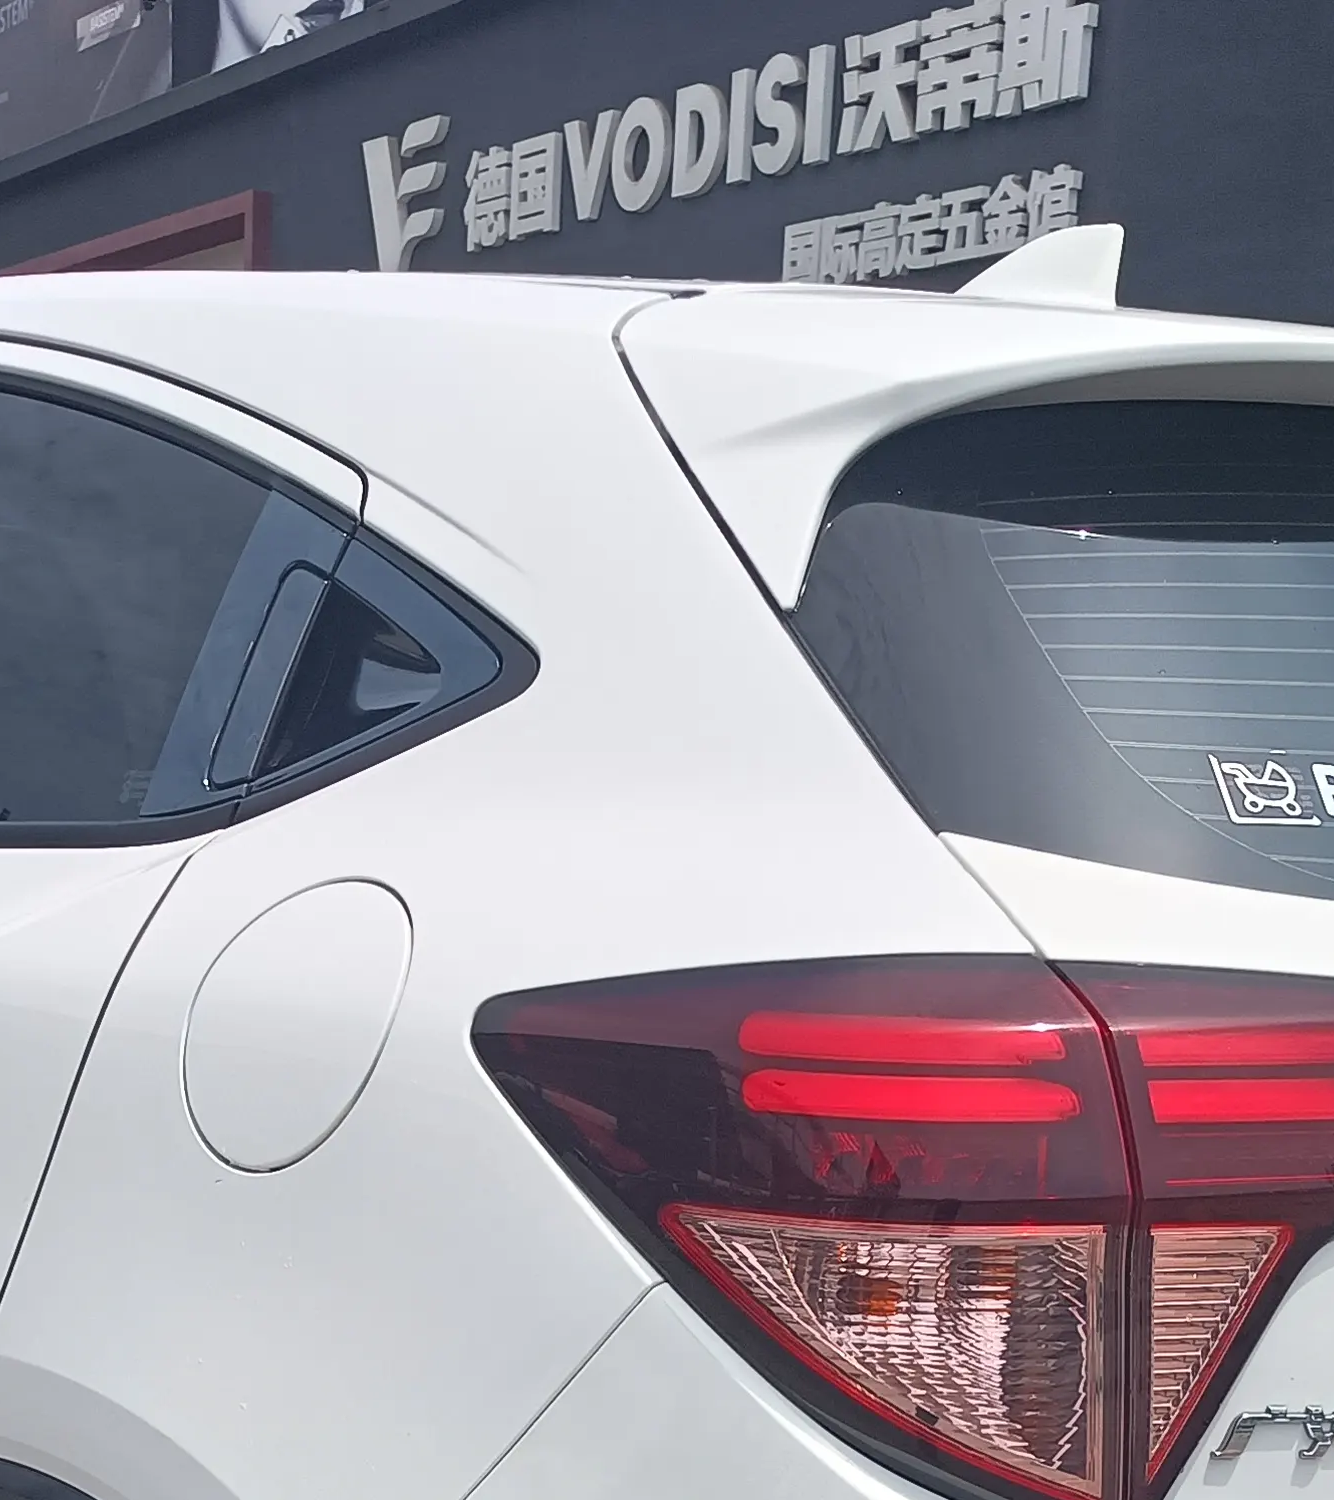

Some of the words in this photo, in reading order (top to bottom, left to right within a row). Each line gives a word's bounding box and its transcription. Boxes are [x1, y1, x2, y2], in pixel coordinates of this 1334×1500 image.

[782, 164, 1083, 284] 国际高定五金馆
